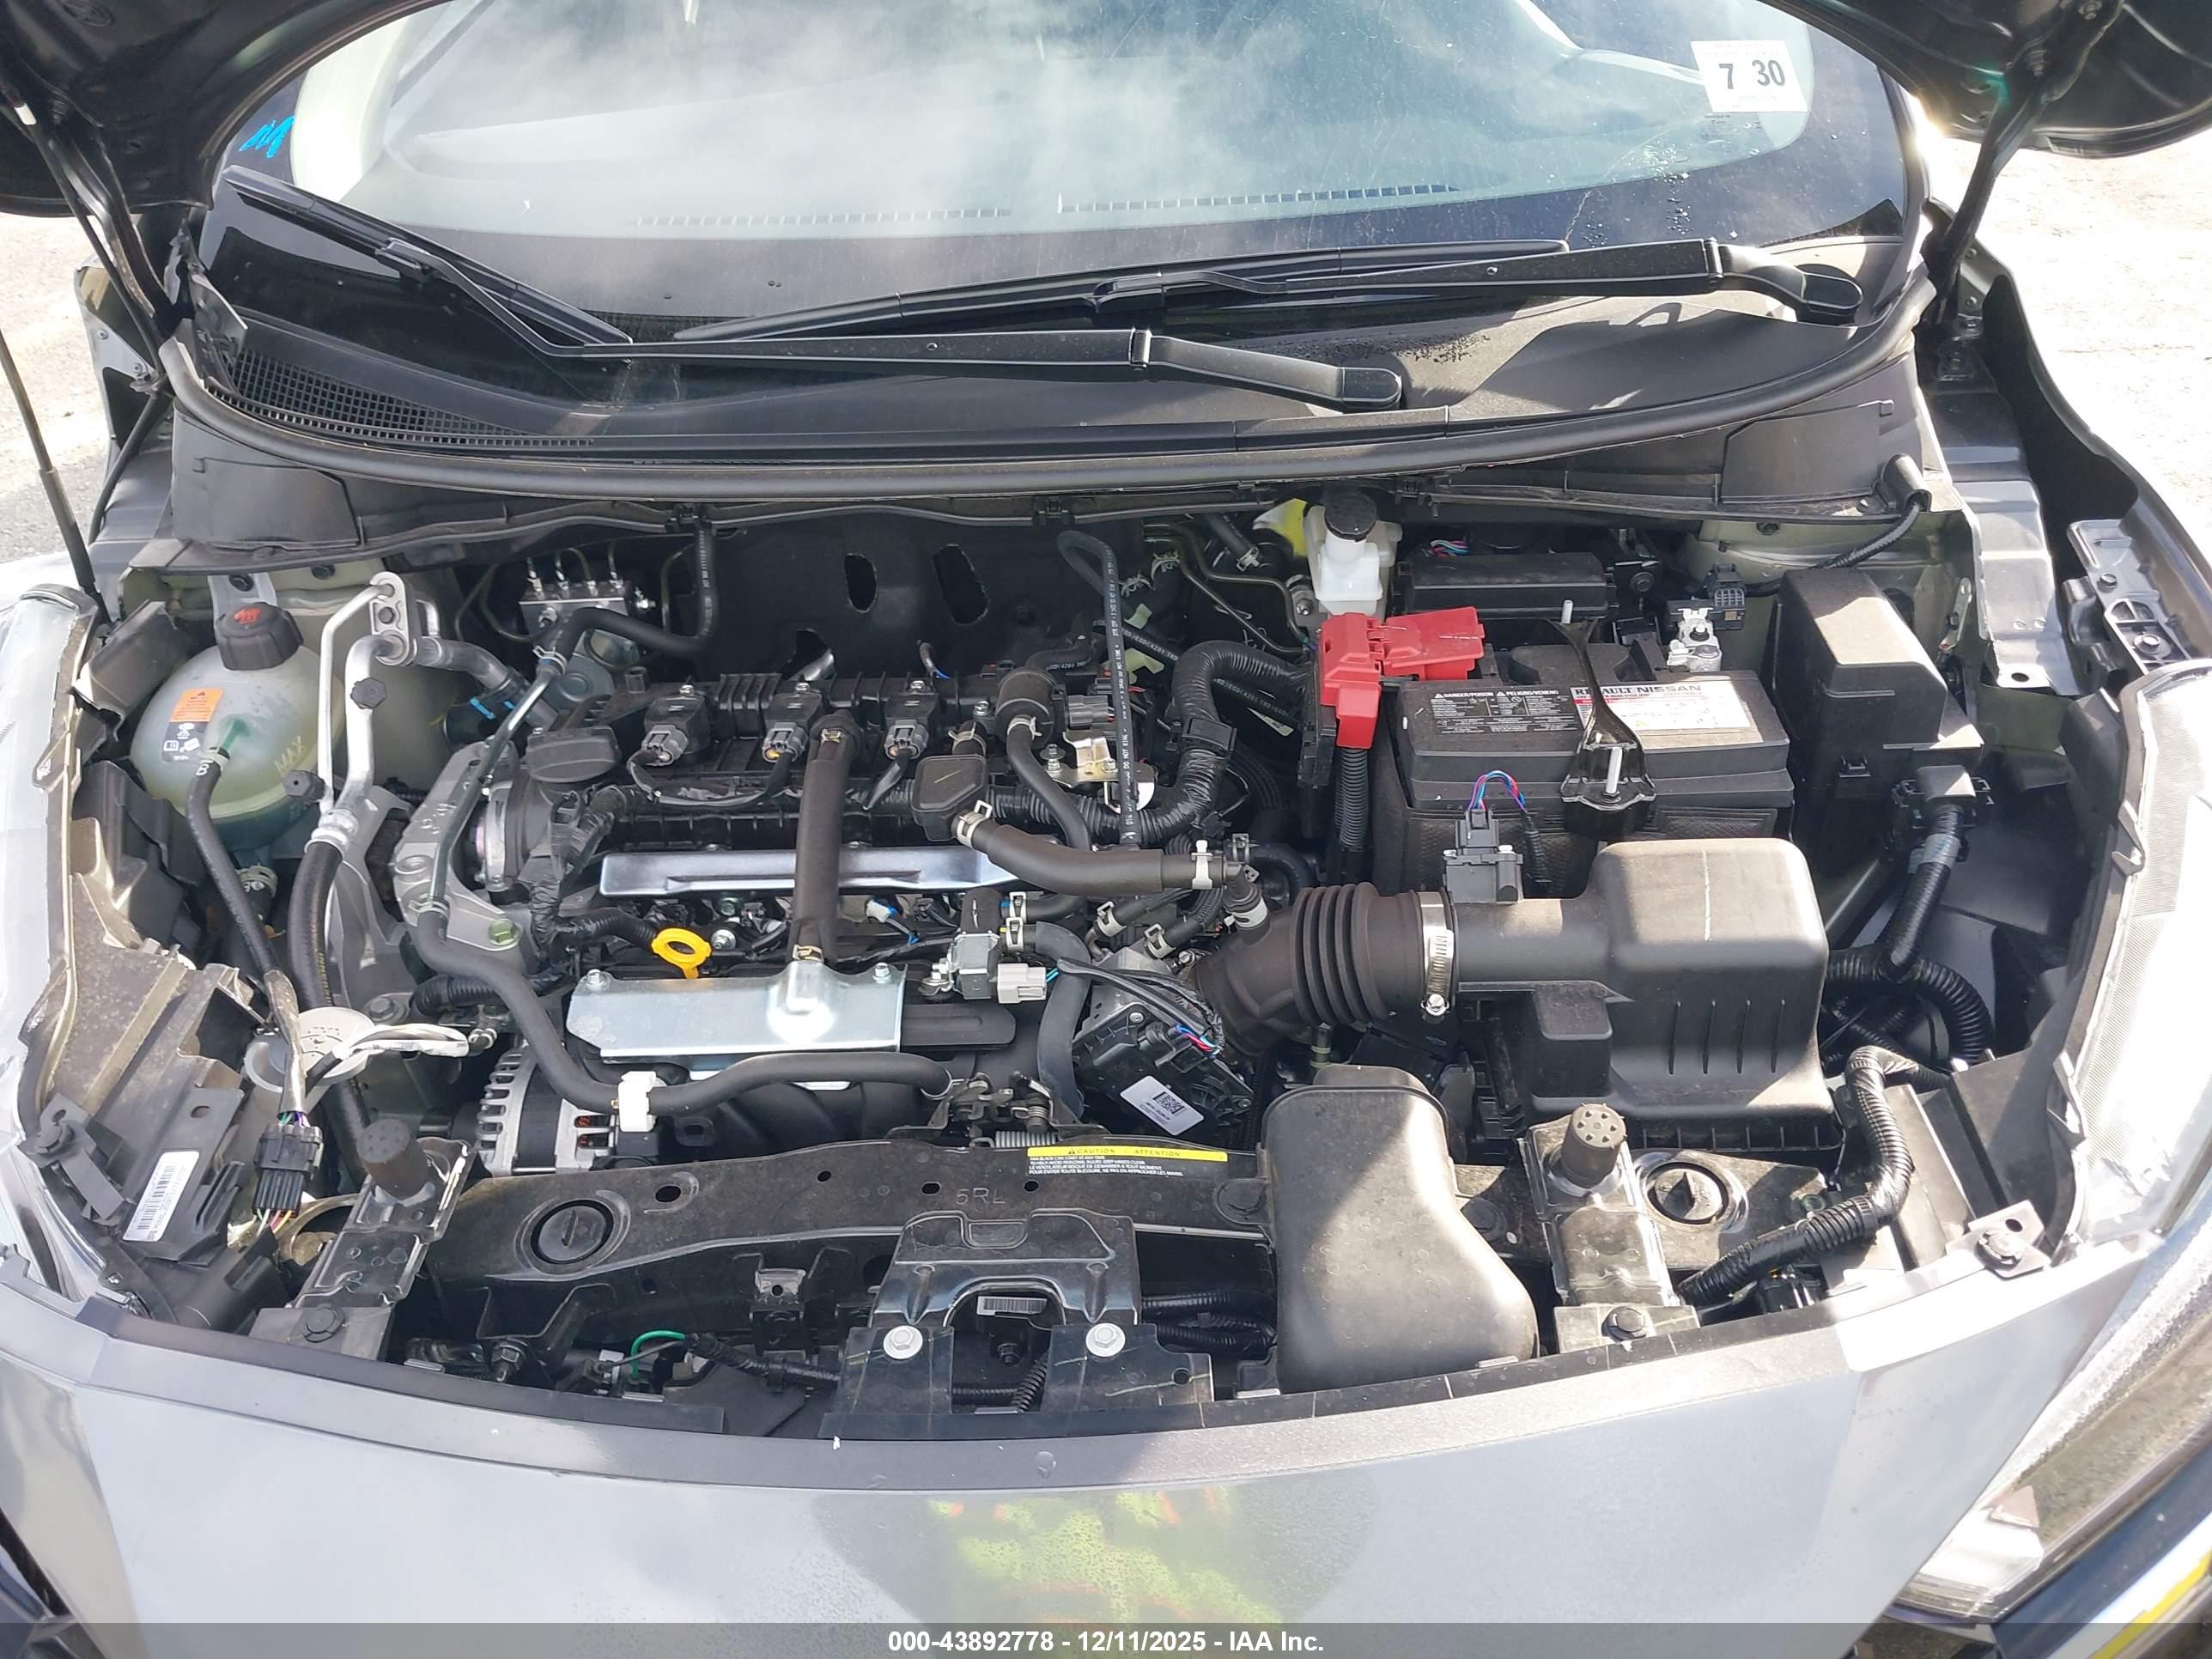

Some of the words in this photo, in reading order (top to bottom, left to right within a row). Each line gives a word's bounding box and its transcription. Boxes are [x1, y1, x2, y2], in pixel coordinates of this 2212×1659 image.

[1717, 63, 1735, 90] 7
[1751, 59, 1785, 87] 30
[1637, 684, 1702, 694] NISSAN
